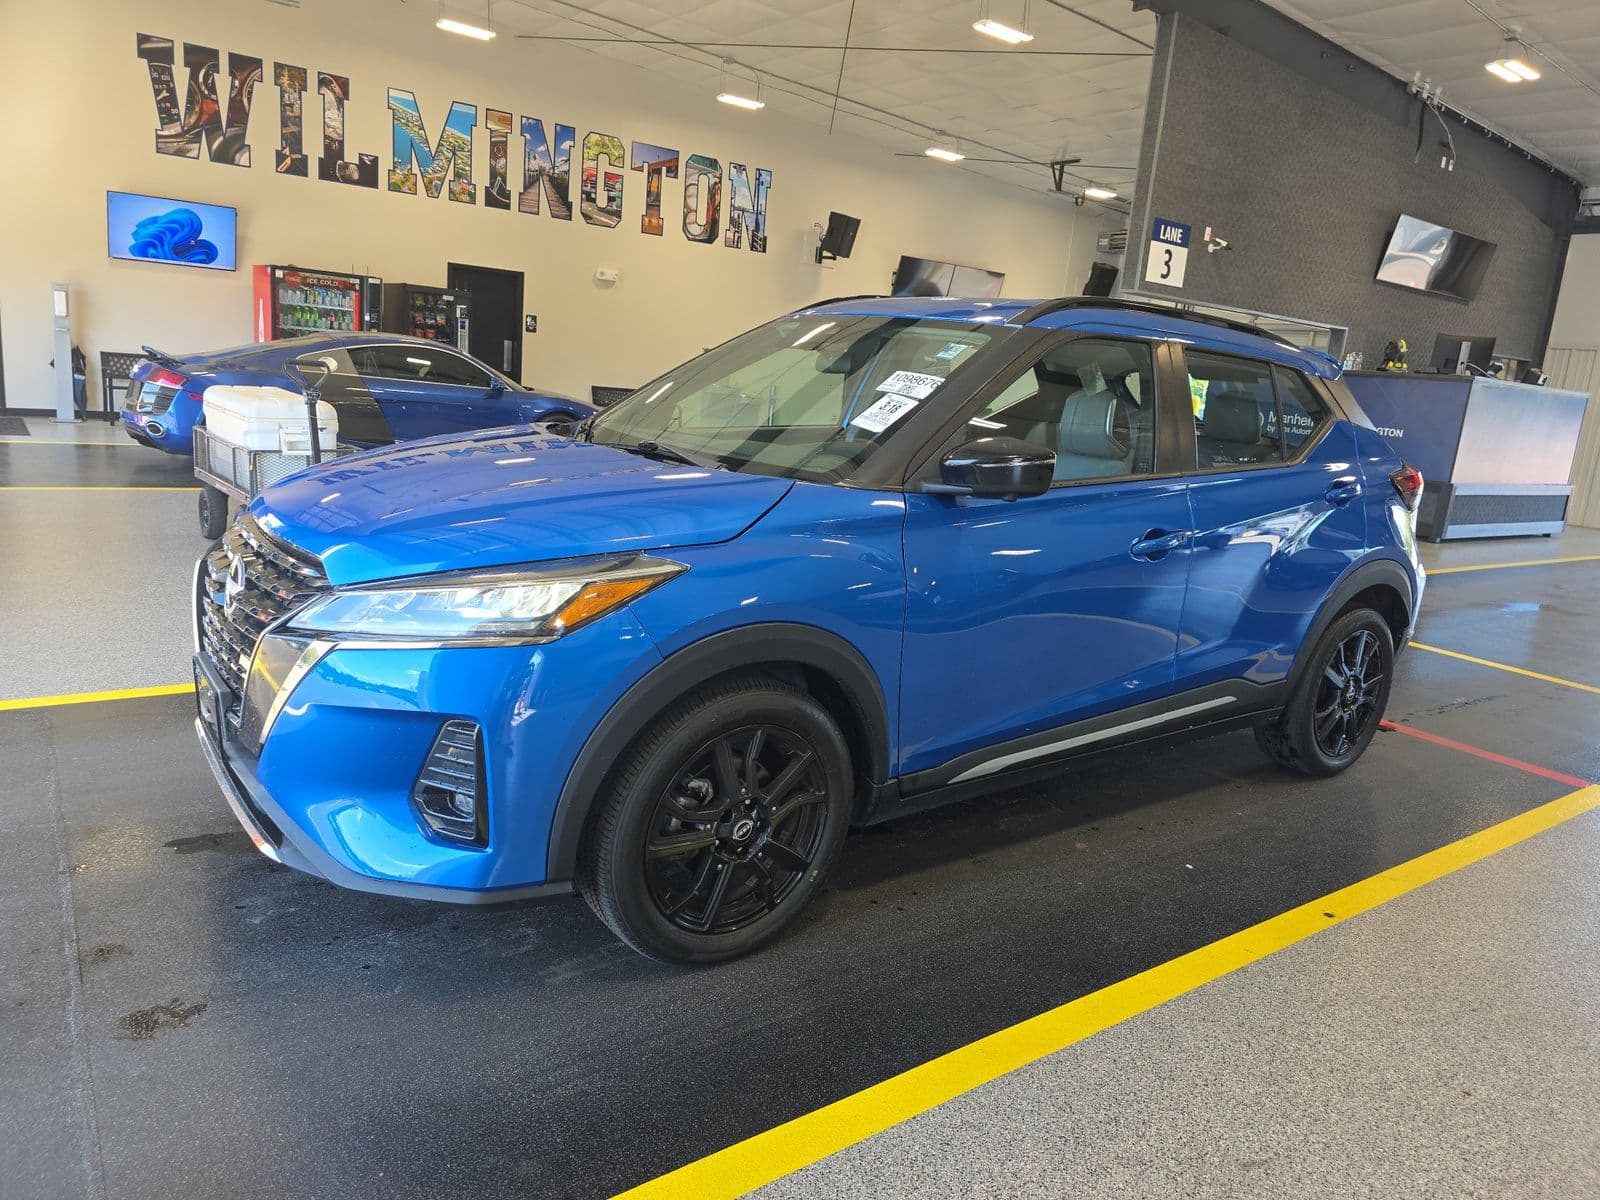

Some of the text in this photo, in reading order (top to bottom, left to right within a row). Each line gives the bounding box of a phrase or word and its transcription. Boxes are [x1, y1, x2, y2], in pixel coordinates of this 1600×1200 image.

[136, 32, 772, 254] WILMINGTON
[1160, 224, 1183, 243] LANE
[1160, 249, 1173, 280] 3
